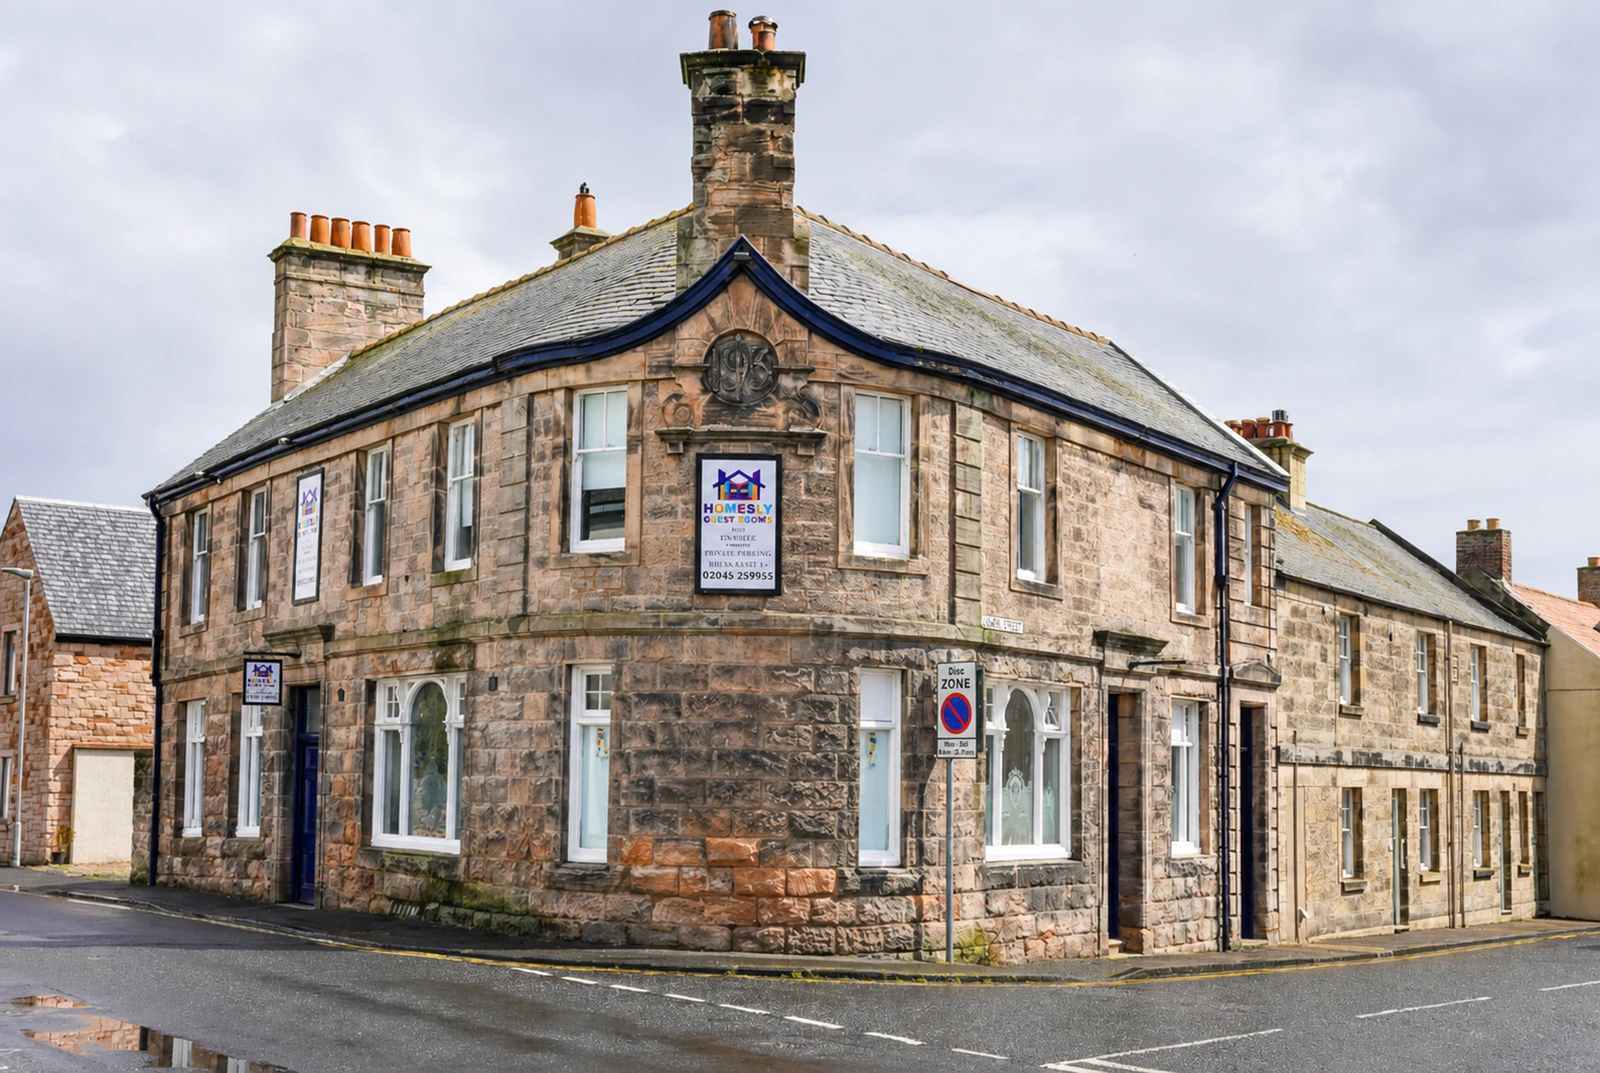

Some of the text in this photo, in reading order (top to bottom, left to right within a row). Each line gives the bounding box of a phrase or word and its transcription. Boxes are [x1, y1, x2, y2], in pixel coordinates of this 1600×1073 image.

[703, 503, 773, 514] HOMESLY
[702, 571, 774, 581] 02045 259955
[948, 666, 965, 675] Disc
[941, 678, 970, 689] ZONE
